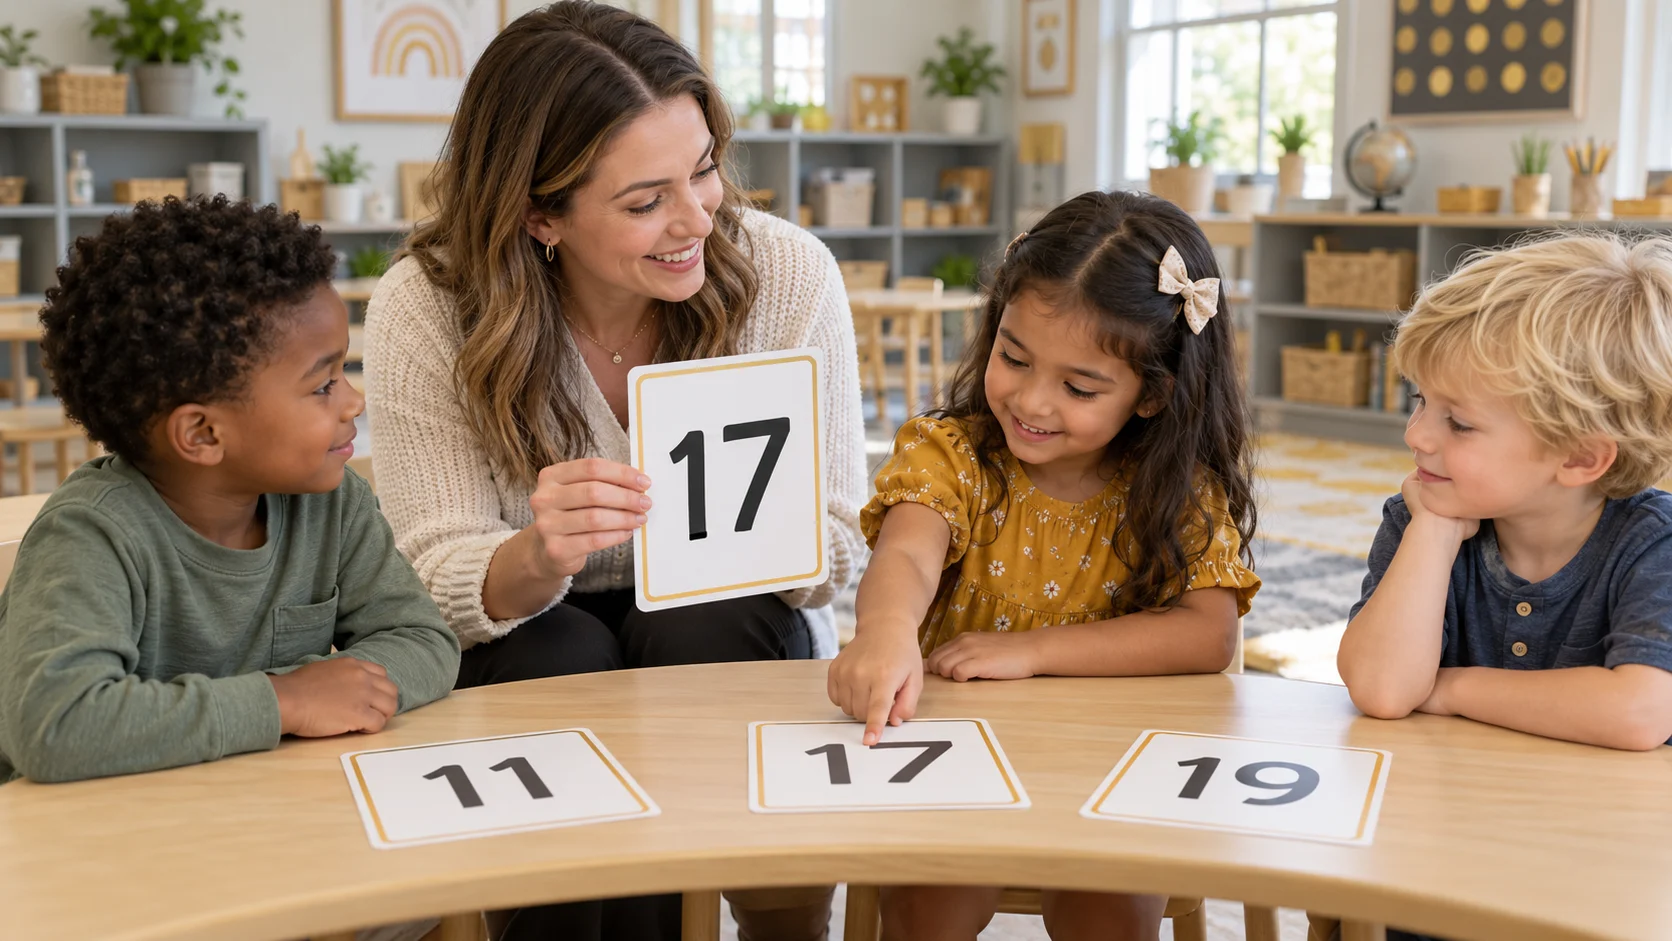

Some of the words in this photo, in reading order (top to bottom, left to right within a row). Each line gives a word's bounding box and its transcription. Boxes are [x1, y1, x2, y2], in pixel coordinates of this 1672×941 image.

[669, 416, 791, 541] 17
[422, 756, 554, 808] 11
[804, 740, 953, 785] 17
[1177, 756, 1320, 806] 19
